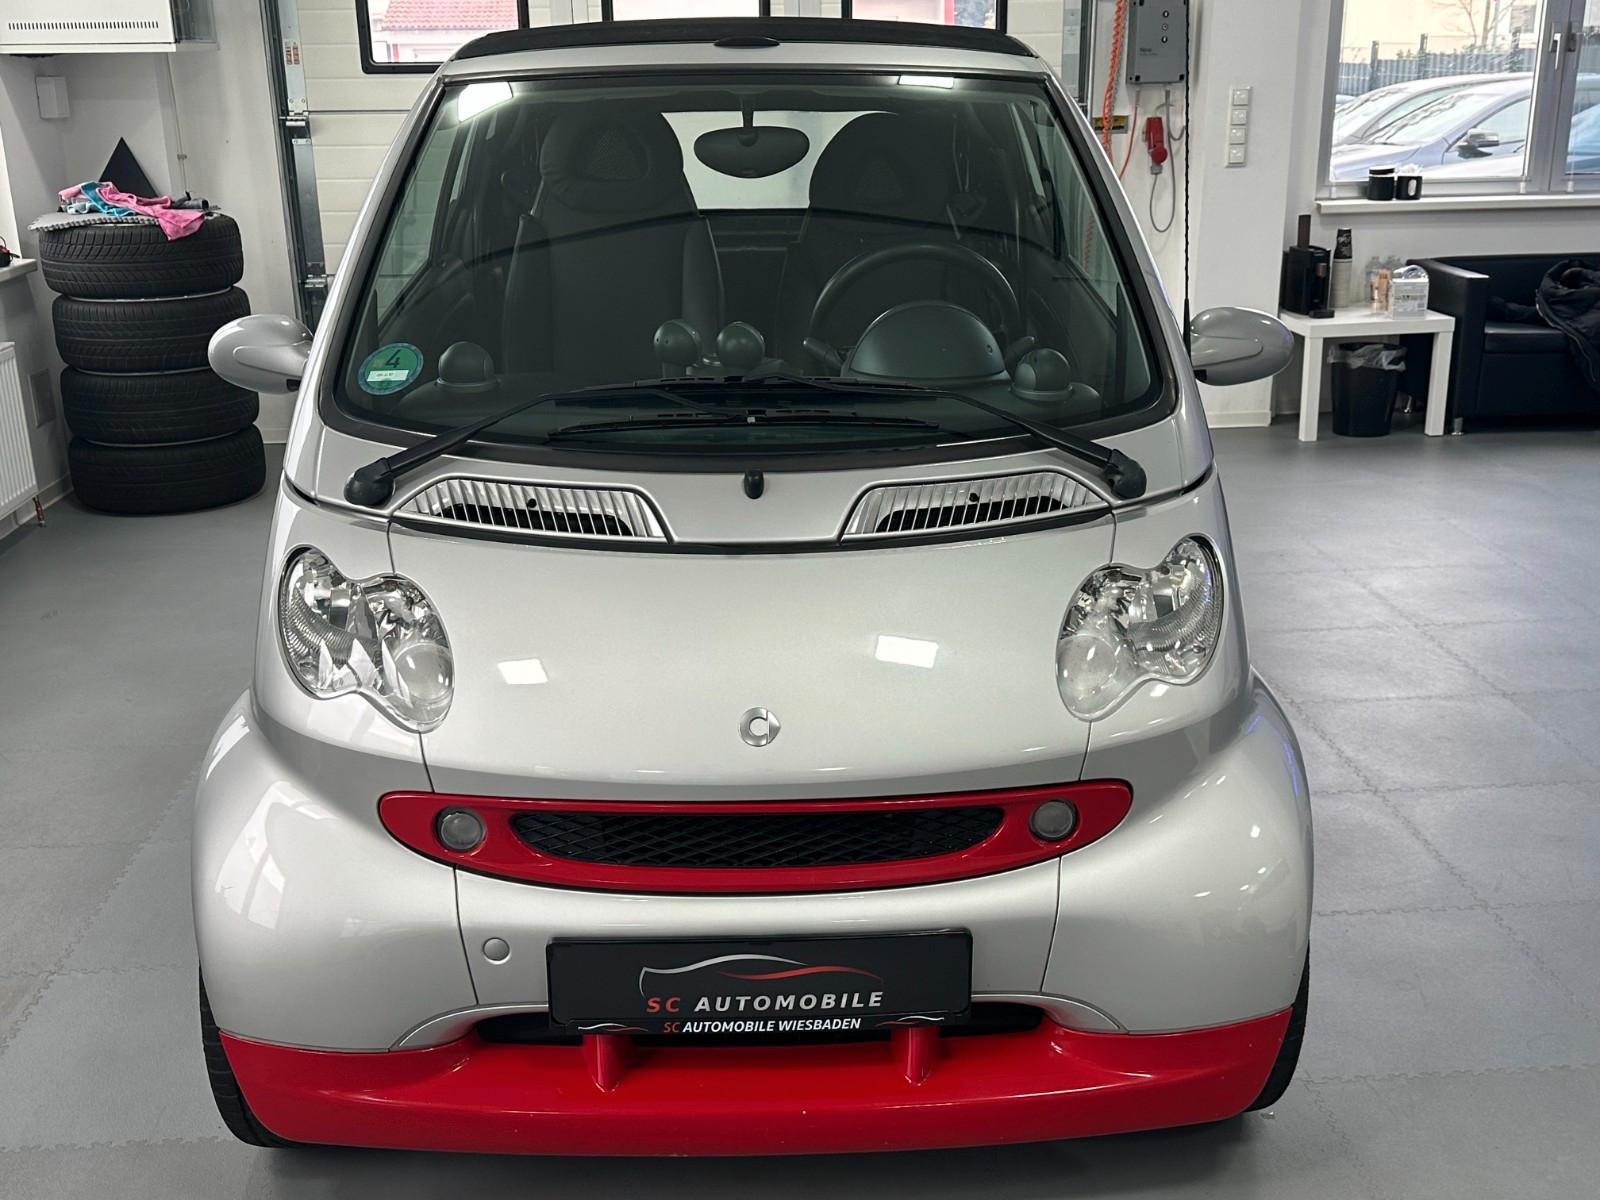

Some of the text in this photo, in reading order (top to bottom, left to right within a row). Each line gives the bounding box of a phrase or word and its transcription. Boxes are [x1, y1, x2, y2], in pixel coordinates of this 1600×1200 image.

[385, 349, 401, 368] 4
[646, 992, 883, 1013] SC AUTOMOBILE
[663, 1018, 861, 1033] SC AUTOMOBILE WIESBADEN
